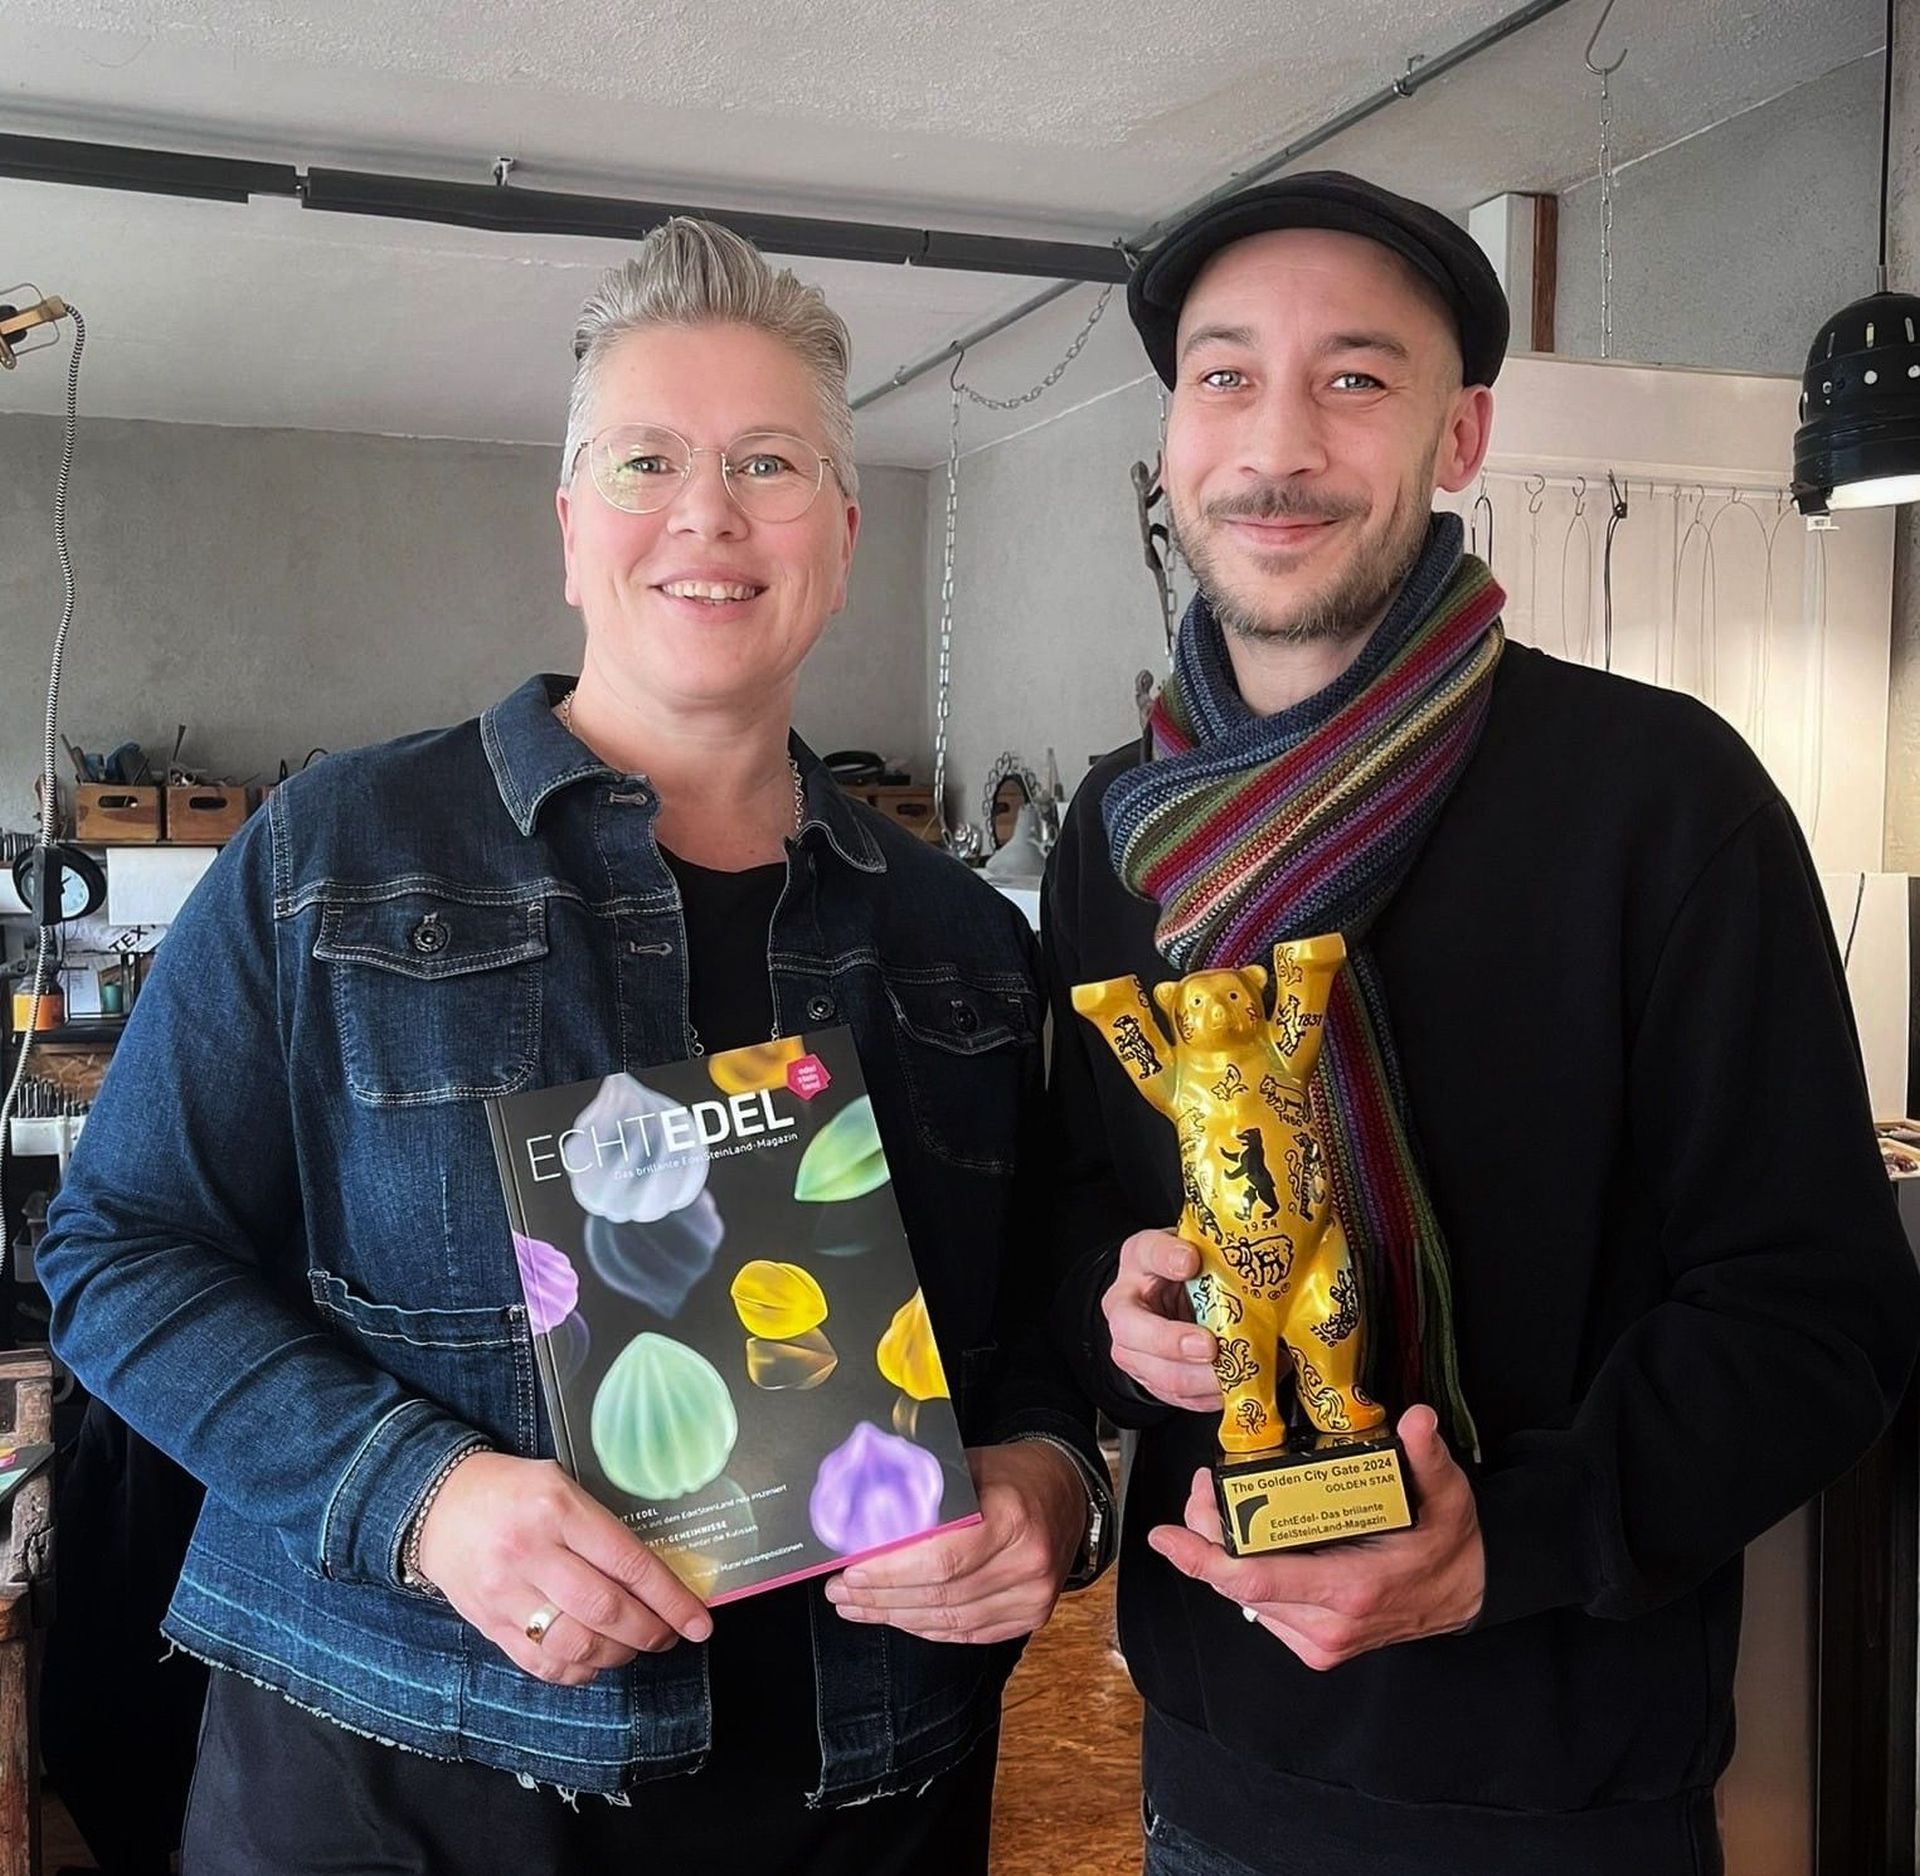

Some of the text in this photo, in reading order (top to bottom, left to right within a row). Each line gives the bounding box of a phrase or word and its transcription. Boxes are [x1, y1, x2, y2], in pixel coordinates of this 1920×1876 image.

[108, 924, 156, 952] TEX
[525, 1089, 795, 1182] ECHTEDEL
[636, 1158, 680, 1178] brillante
[1244, 1219, 1278, 1233] 1954
[1231, 1457, 1392, 1494] The Golden City Gate 2024
[1325, 1474, 1396, 1494] GOLDEN STAR
[1269, 1514, 1388, 1542] EdelSteinLand-Magazin
[1270, 1502, 1384, 1529] EchtEdel- Das brillante
